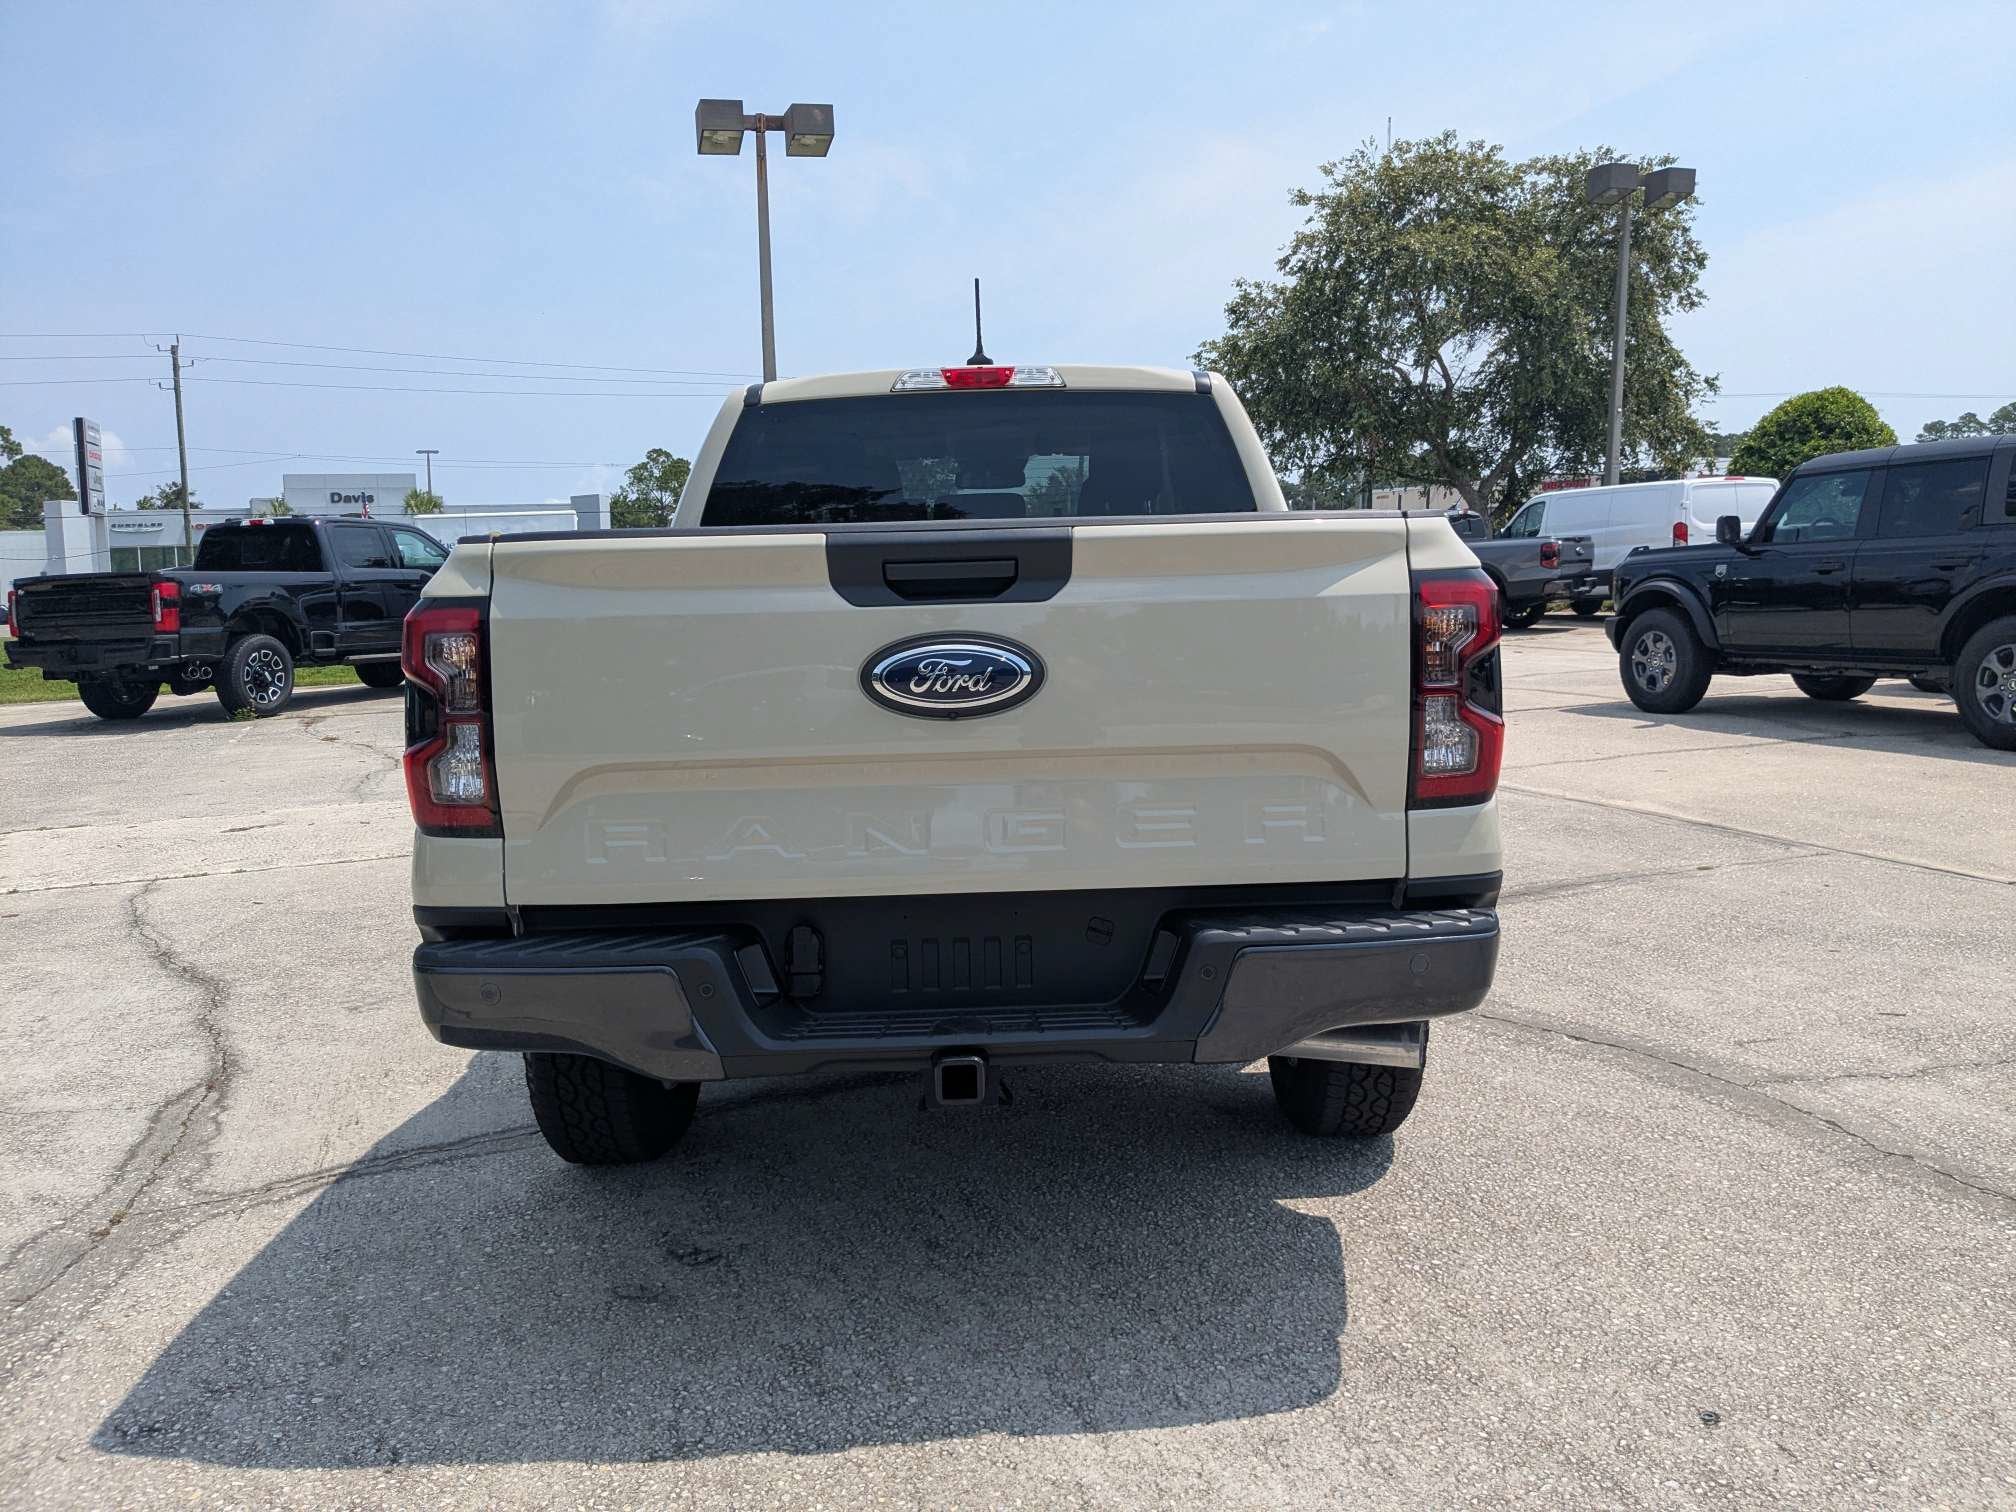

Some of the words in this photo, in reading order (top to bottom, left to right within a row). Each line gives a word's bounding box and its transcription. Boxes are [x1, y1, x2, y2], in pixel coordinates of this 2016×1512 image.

[330, 491, 375, 504] Davis
[909, 658, 994, 694] Ford
[585, 800, 1326, 864] RANGER
